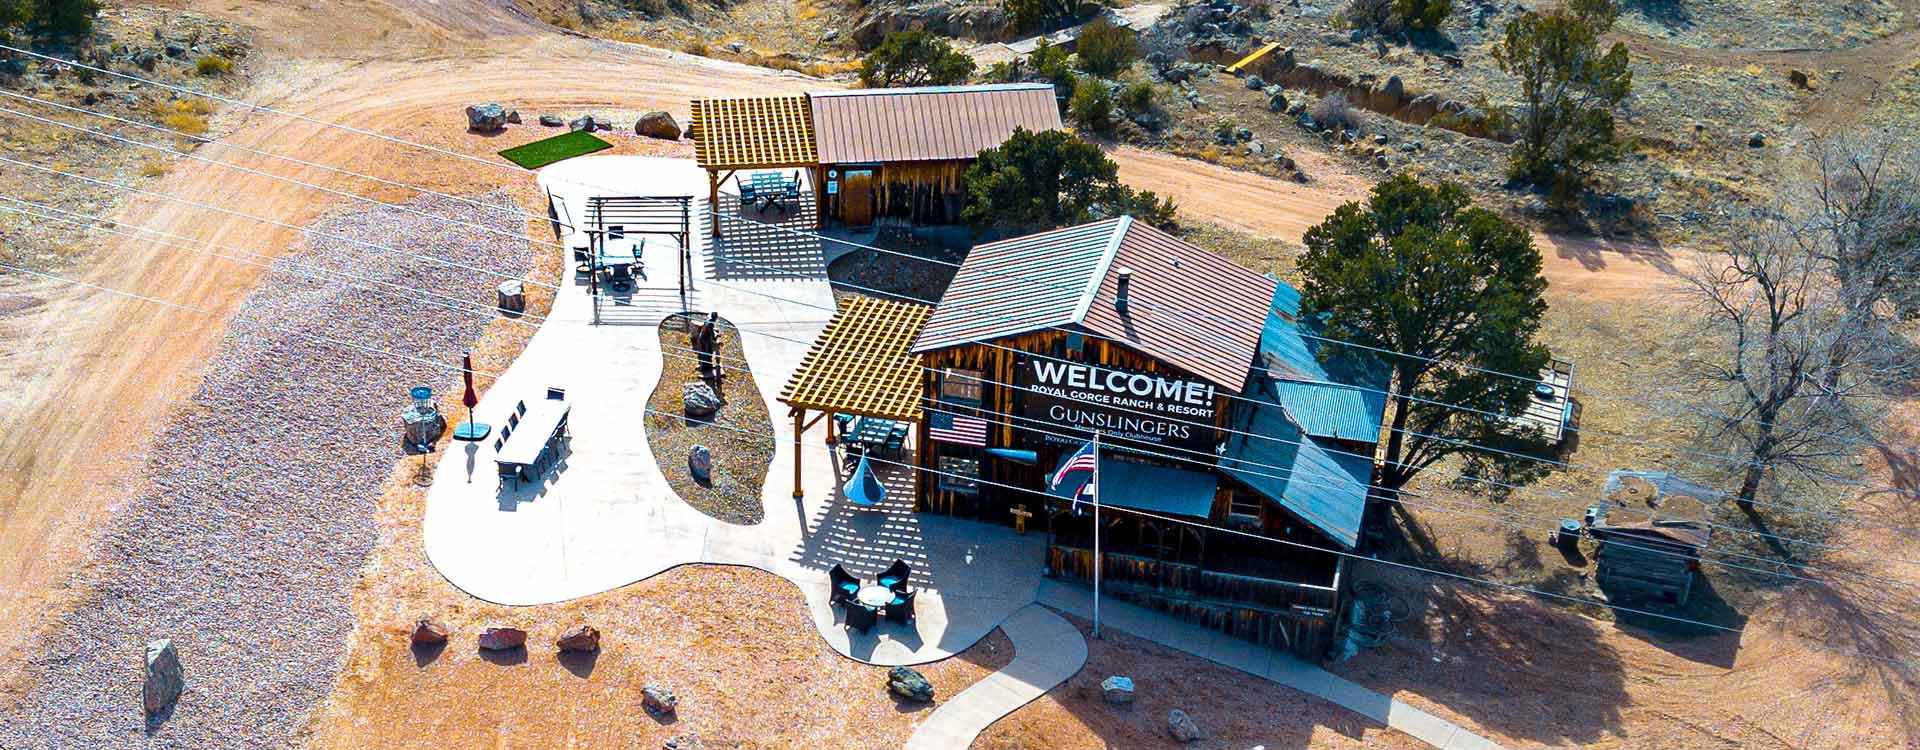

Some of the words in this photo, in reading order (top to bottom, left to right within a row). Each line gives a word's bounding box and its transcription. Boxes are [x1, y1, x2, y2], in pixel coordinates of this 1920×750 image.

[1033, 360, 1215, 407] WELCOME!
[1031, 384, 1067, 398] ROYAL
[1070, 390, 1110, 404] GORGE
[1113, 396, 1153, 409] RANCH
[1156, 403, 1164, 411] &
[1168, 404, 1214, 418] RESORT
[1050, 405, 1190, 439] GUNSLINGERS
[1108, 429, 1124, 438] Only
[1125, 431, 1162, 443] Clubhouse
